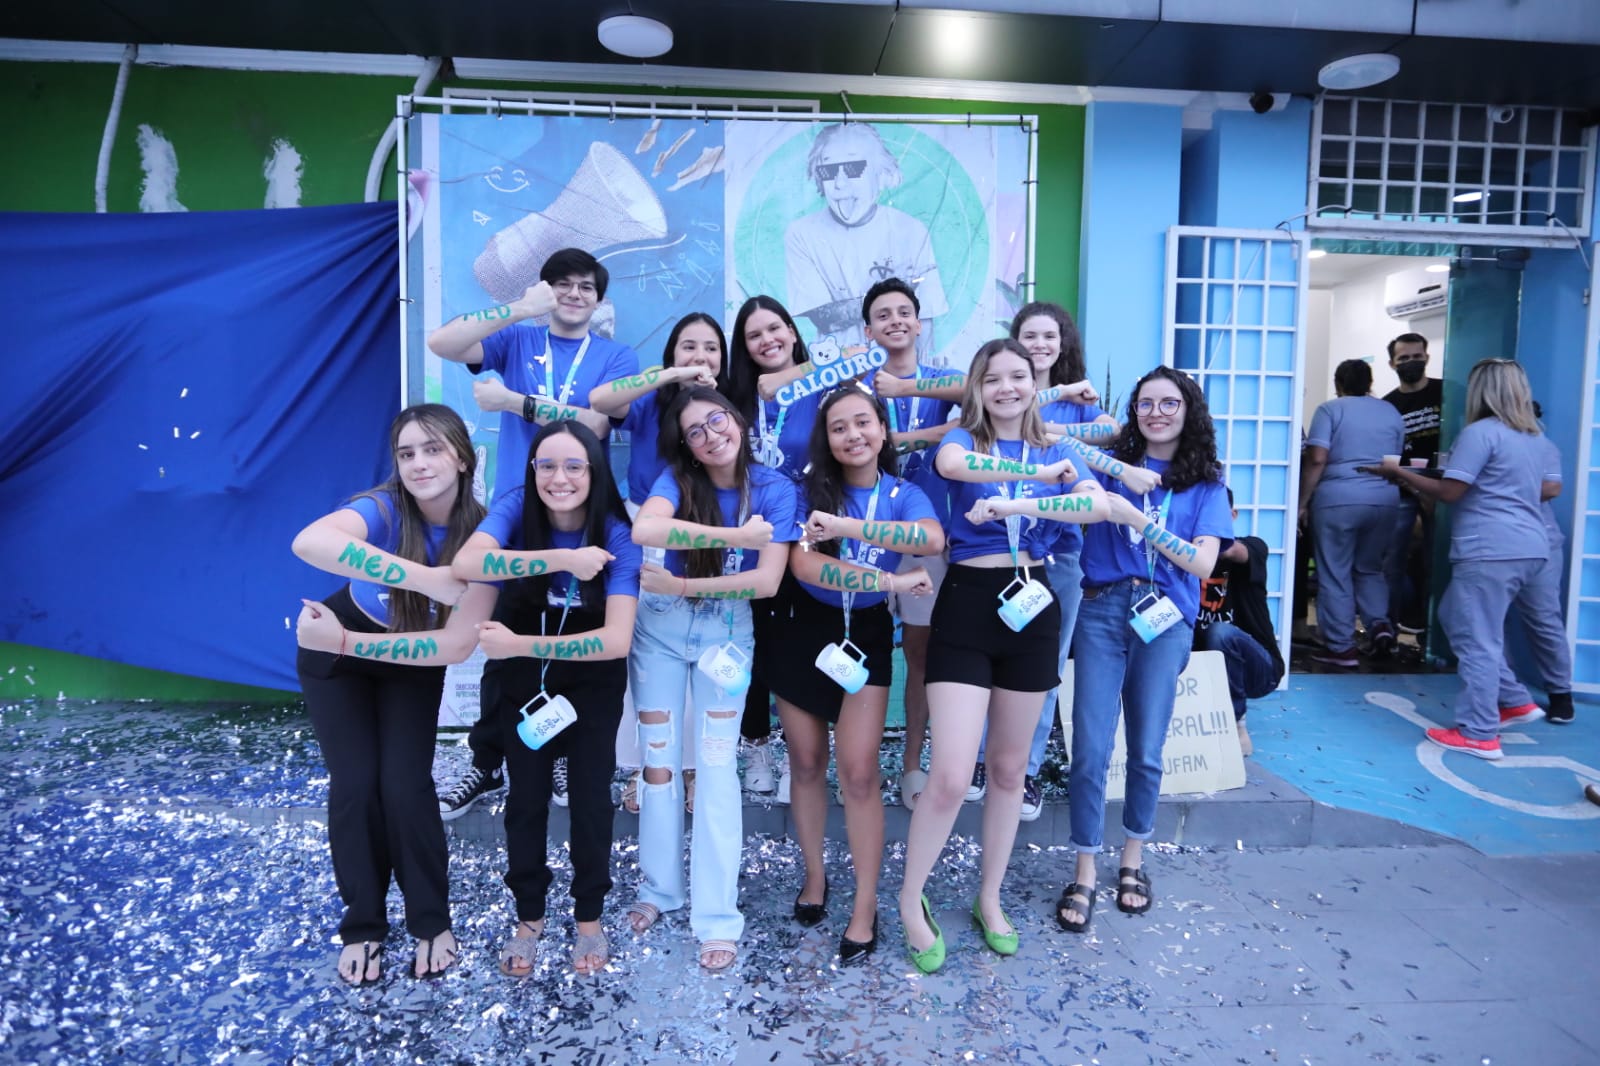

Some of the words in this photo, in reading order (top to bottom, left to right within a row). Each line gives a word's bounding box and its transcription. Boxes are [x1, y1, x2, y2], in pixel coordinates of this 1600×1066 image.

[464, 305, 512, 321] MED
[612, 371, 659, 392] MED
[775, 346, 888, 406] CALOURO
[916, 374, 964, 391] UFAM
[1066, 423, 1113, 438] UFAM
[1038, 496, 1092, 512] UFAM
[862, 522, 928, 546] UFAM
[1144, 523, 1197, 562] UFAM
[338, 542, 406, 585] MED
[482, 552, 548, 576] MED
[820, 563, 876, 591] MED
[354, 637, 438, 660] UFAM
[533, 636, 604, 658] UFAM
